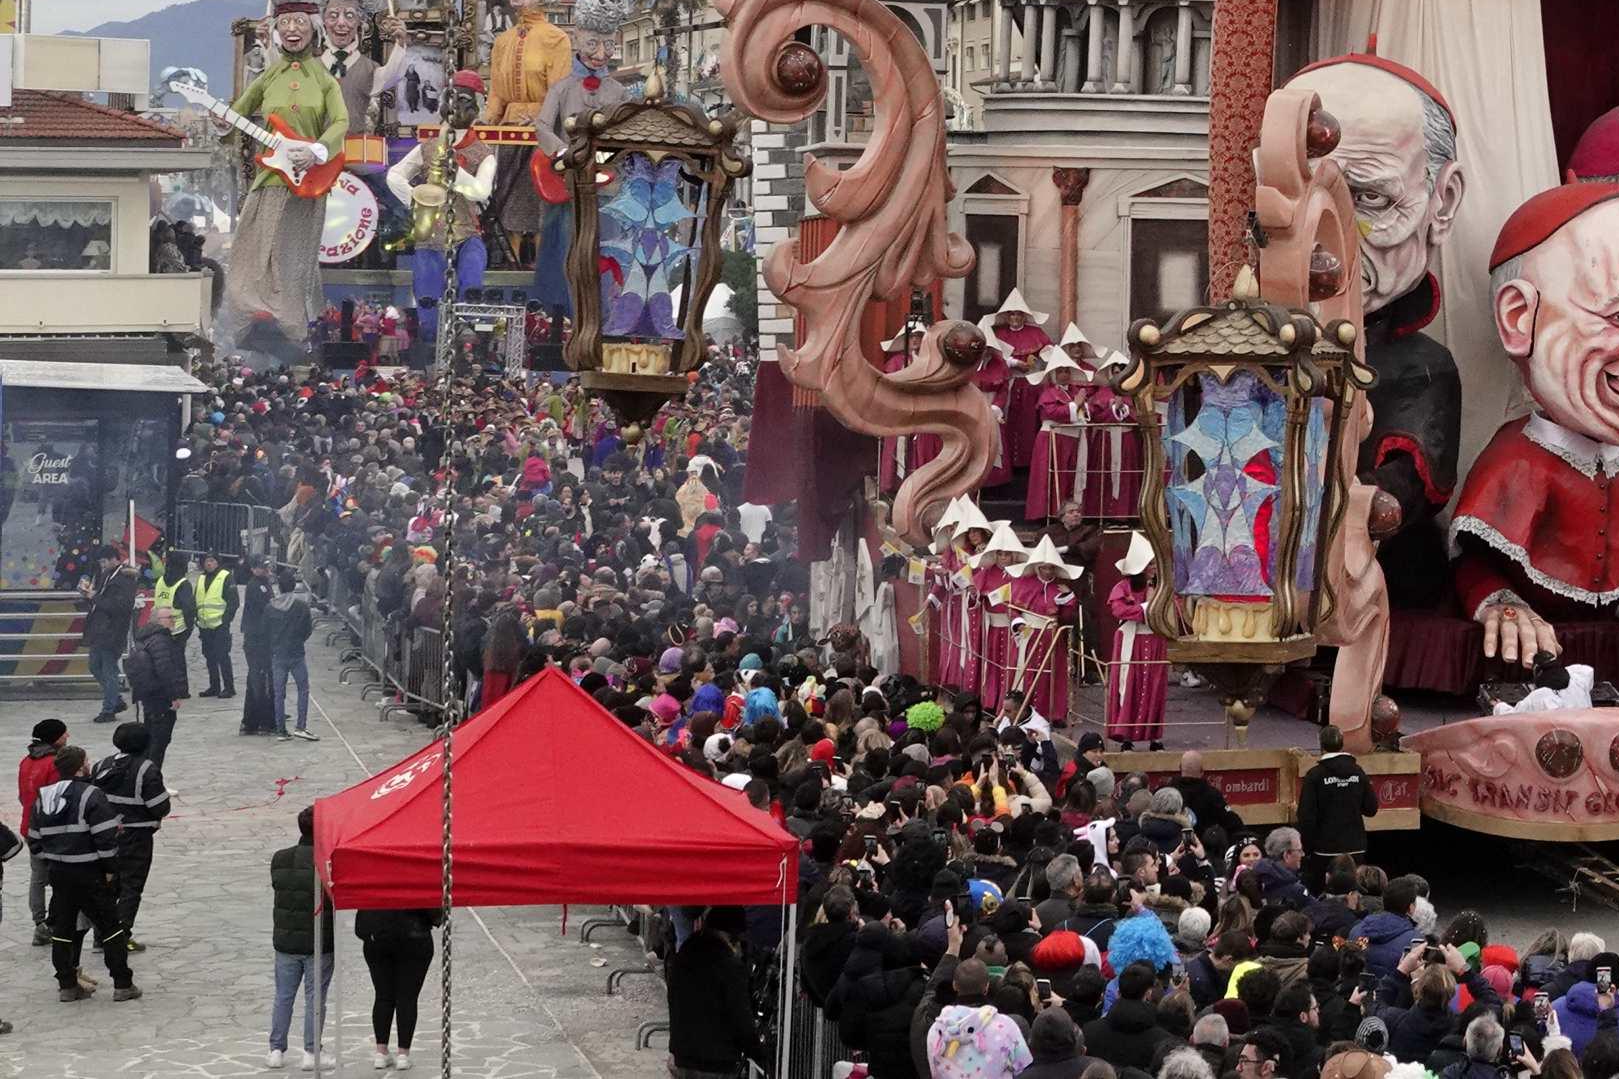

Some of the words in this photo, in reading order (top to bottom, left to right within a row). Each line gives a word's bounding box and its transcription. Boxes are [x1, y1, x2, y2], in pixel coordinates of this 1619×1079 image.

[28, 452, 74, 473] Guest
[32, 473, 68, 484] AREA
[1469, 780, 1579, 813] TRANSIT
